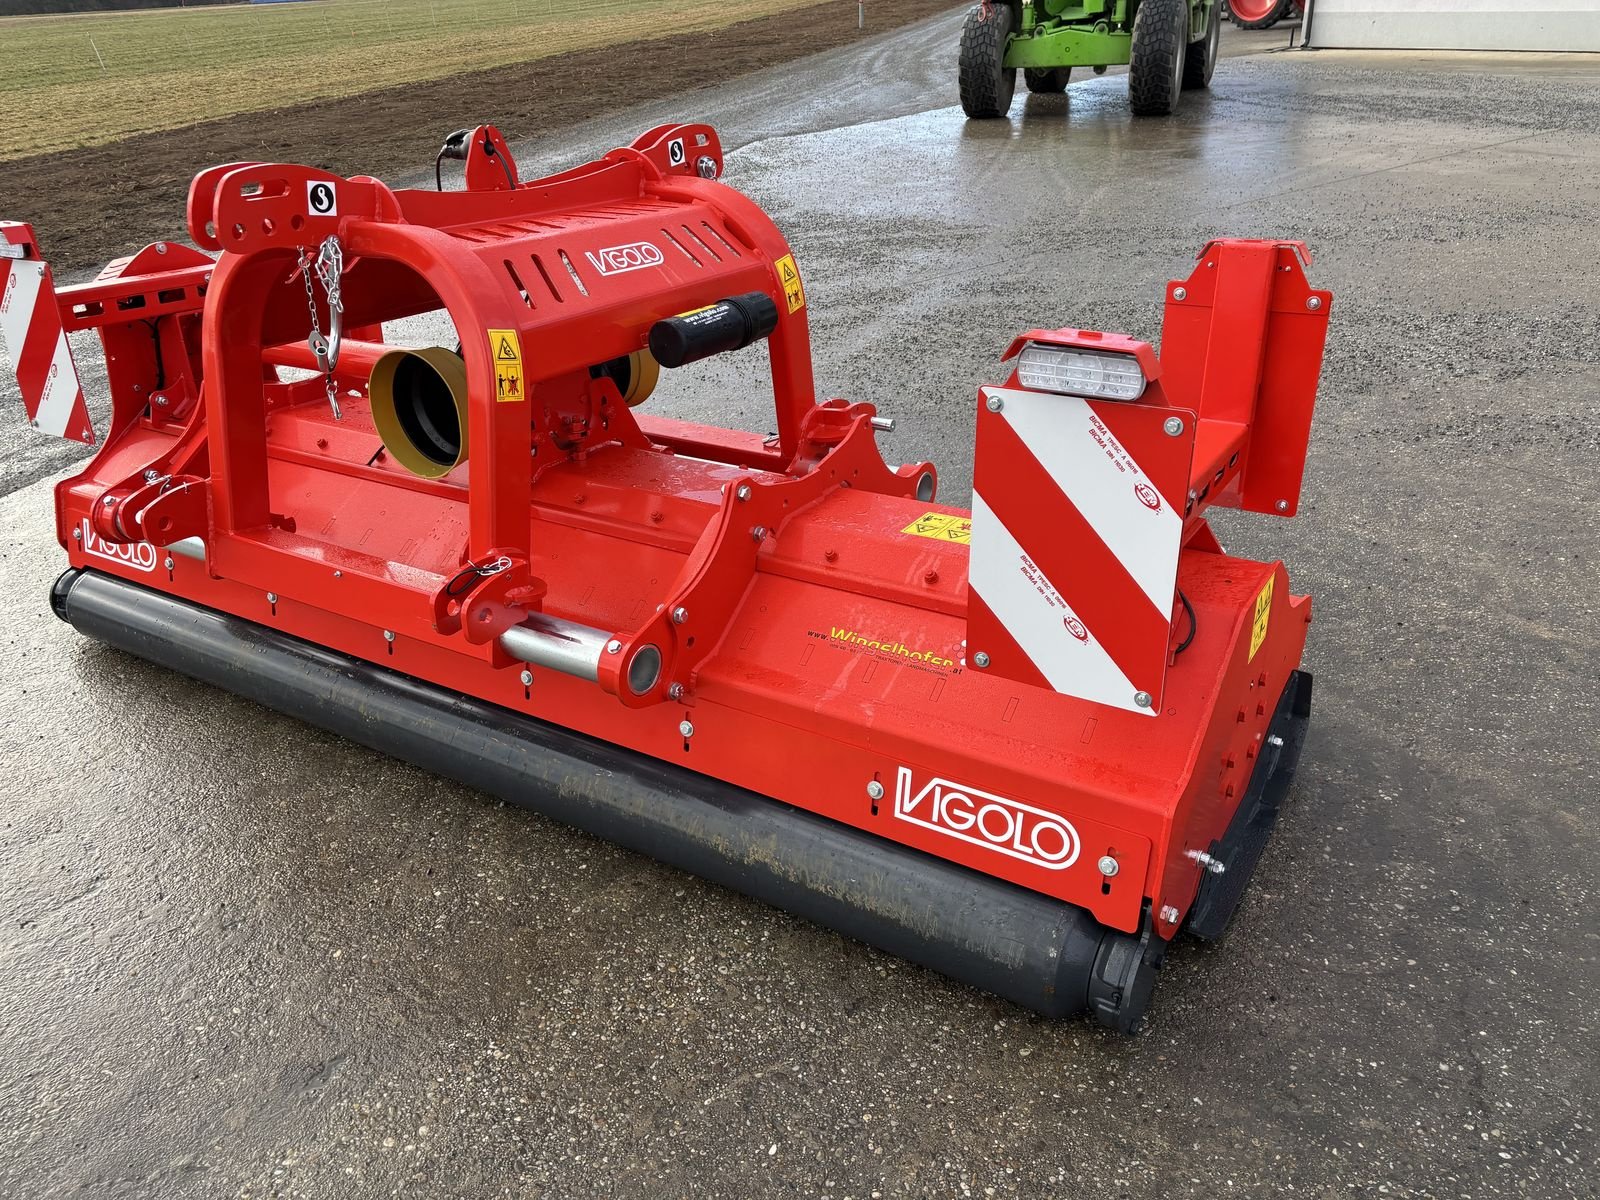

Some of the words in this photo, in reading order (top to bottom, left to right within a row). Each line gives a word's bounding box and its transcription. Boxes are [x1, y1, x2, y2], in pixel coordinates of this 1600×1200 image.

[584, 241, 664, 276] VIGOLO
[1089, 415, 1107, 436] BICMA
[1089, 428, 1107, 449] BICMA
[1020, 555, 1037, 574] BICMA
[1020, 566, 1038, 585] BICMA
[894, 766, 1081, 870] VIGOLO
